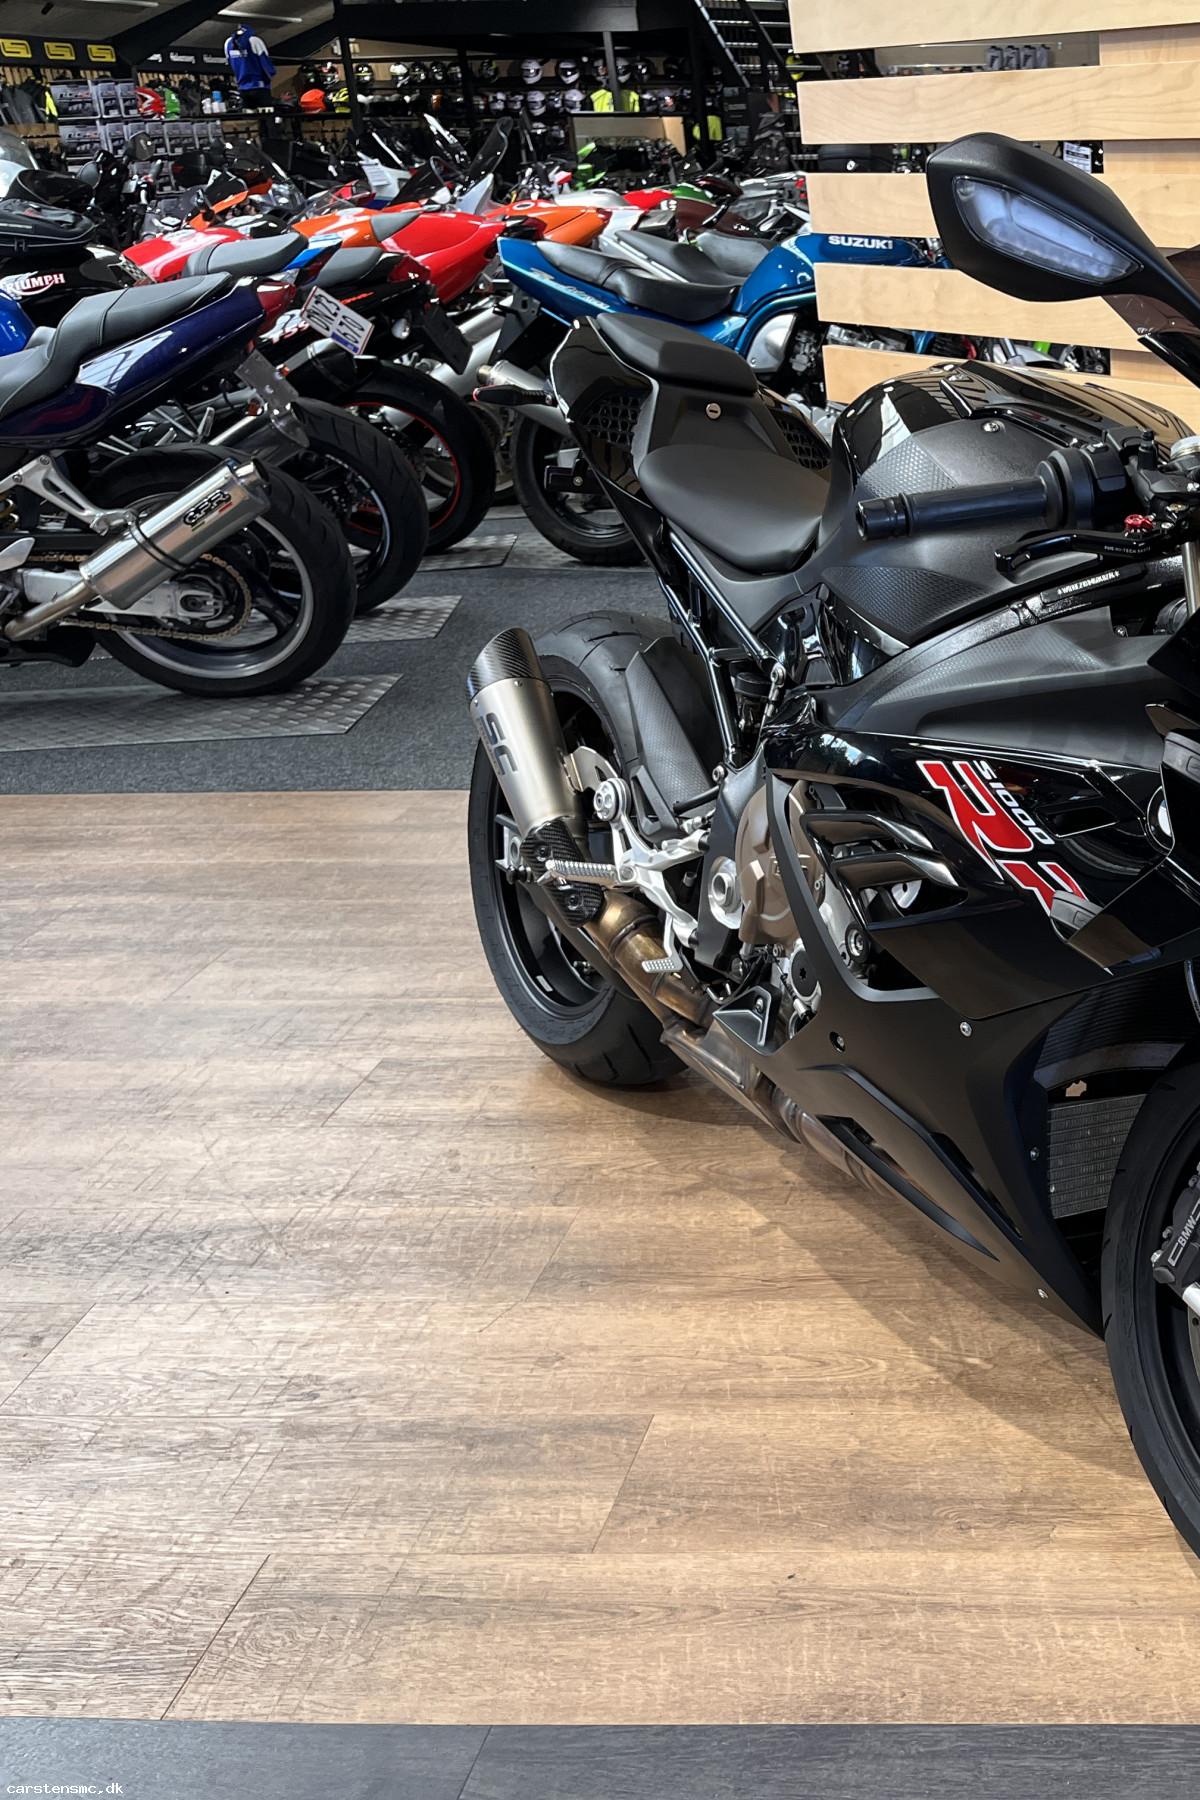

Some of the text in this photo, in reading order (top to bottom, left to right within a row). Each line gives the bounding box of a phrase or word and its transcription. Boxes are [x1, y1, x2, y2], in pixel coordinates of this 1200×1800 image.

[829, 235, 893, 249] SUZUKI
[336, 314, 366, 344] 670
[480, 712, 519, 775] SC
[976, 760, 1056, 845] S1000
[1178, 1215, 1198, 1248] BMW
